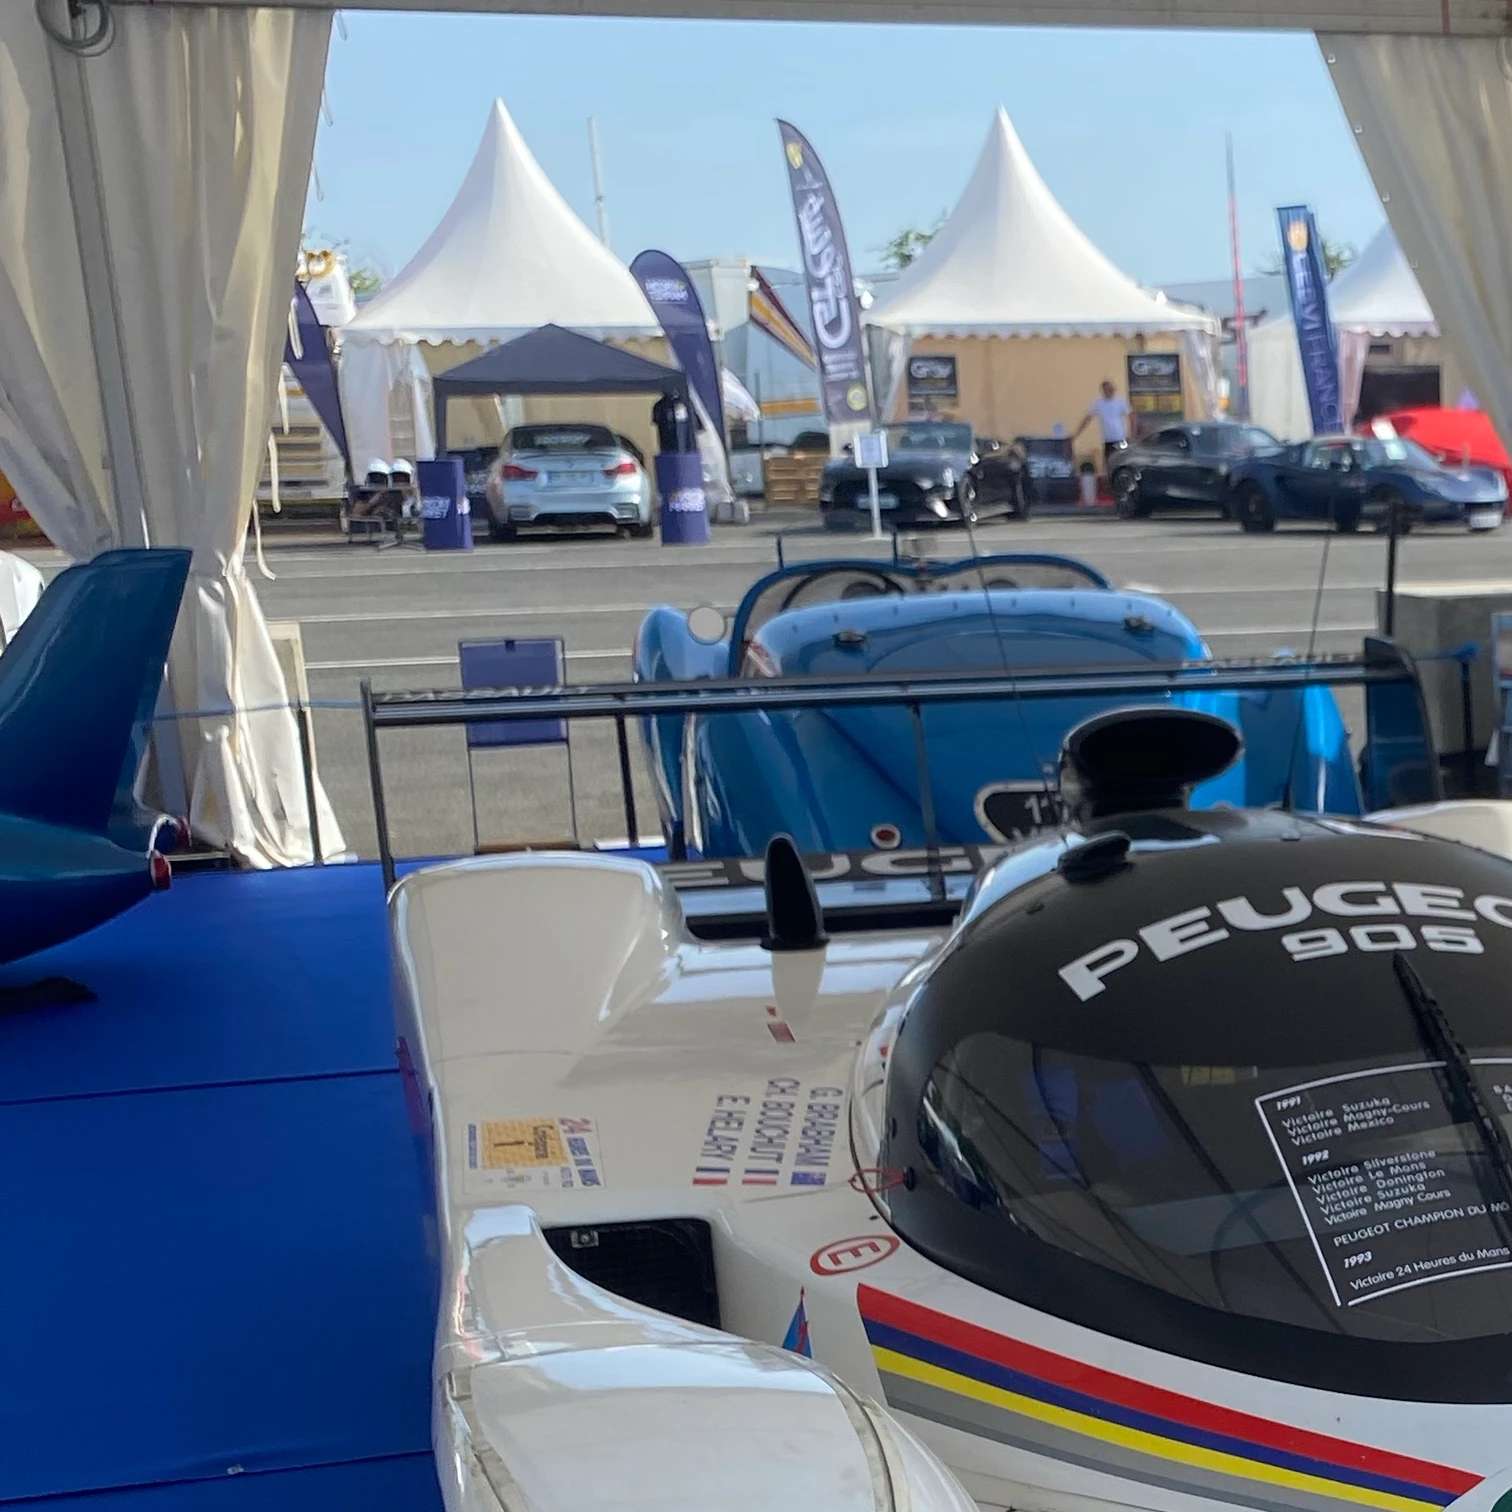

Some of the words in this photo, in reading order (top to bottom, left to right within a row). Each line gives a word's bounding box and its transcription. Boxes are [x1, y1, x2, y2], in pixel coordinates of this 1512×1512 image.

[1281, 924, 1485, 961] 905
[1276, 1096, 1301, 1110] 1991
[1281, 1108, 1333, 1129] Victoire
[1342, 1096, 1391, 1113] Suzuka
[1287, 1117, 1338, 1137] Victoire
[1343, 1101, 1430, 1124] Magny-Cours
[1291, 1126, 1342, 1146] Victoire
[1348, 1116, 1394, 1132] Mexico
[1302, 1150, 1329, 1165] 1992
[1308, 1164, 1359, 1185] Victoire
[1364, 1150, 1436, 1170] Silverstone
[1312, 1174, 1364, 1195] Victoire
[1368, 1169, 1384, 1180] Le
[1390, 1161, 1427, 1175] Mans
[1316, 1184, 1368, 1205] Victoire
[1376, 1168, 1445, 1189] Donington
[1320, 1194, 1372, 1215] Victoire
[1377, 1182, 1426, 1199] Suzuka
[1324, 1207, 1368, 1226] Victoire
[1374, 1196, 1414, 1213] Magny
[1417, 1188, 1451, 1202] Cours
[1333, 1222, 1391, 1247] PEUGEOT
[1394, 1207, 1465, 1230] CHAMPION
[1467, 1203, 1488, 1215] DU
[1344, 1251, 1373, 1269] 1993
[1350, 1270, 1395, 1291] Victoire
[1395, 1263, 1412, 1277] 24
[1414, 1255, 1457, 1273] Heures
[1458, 1249, 1475, 1263] du
[1476, 1246, 1510, 1260] Mans
